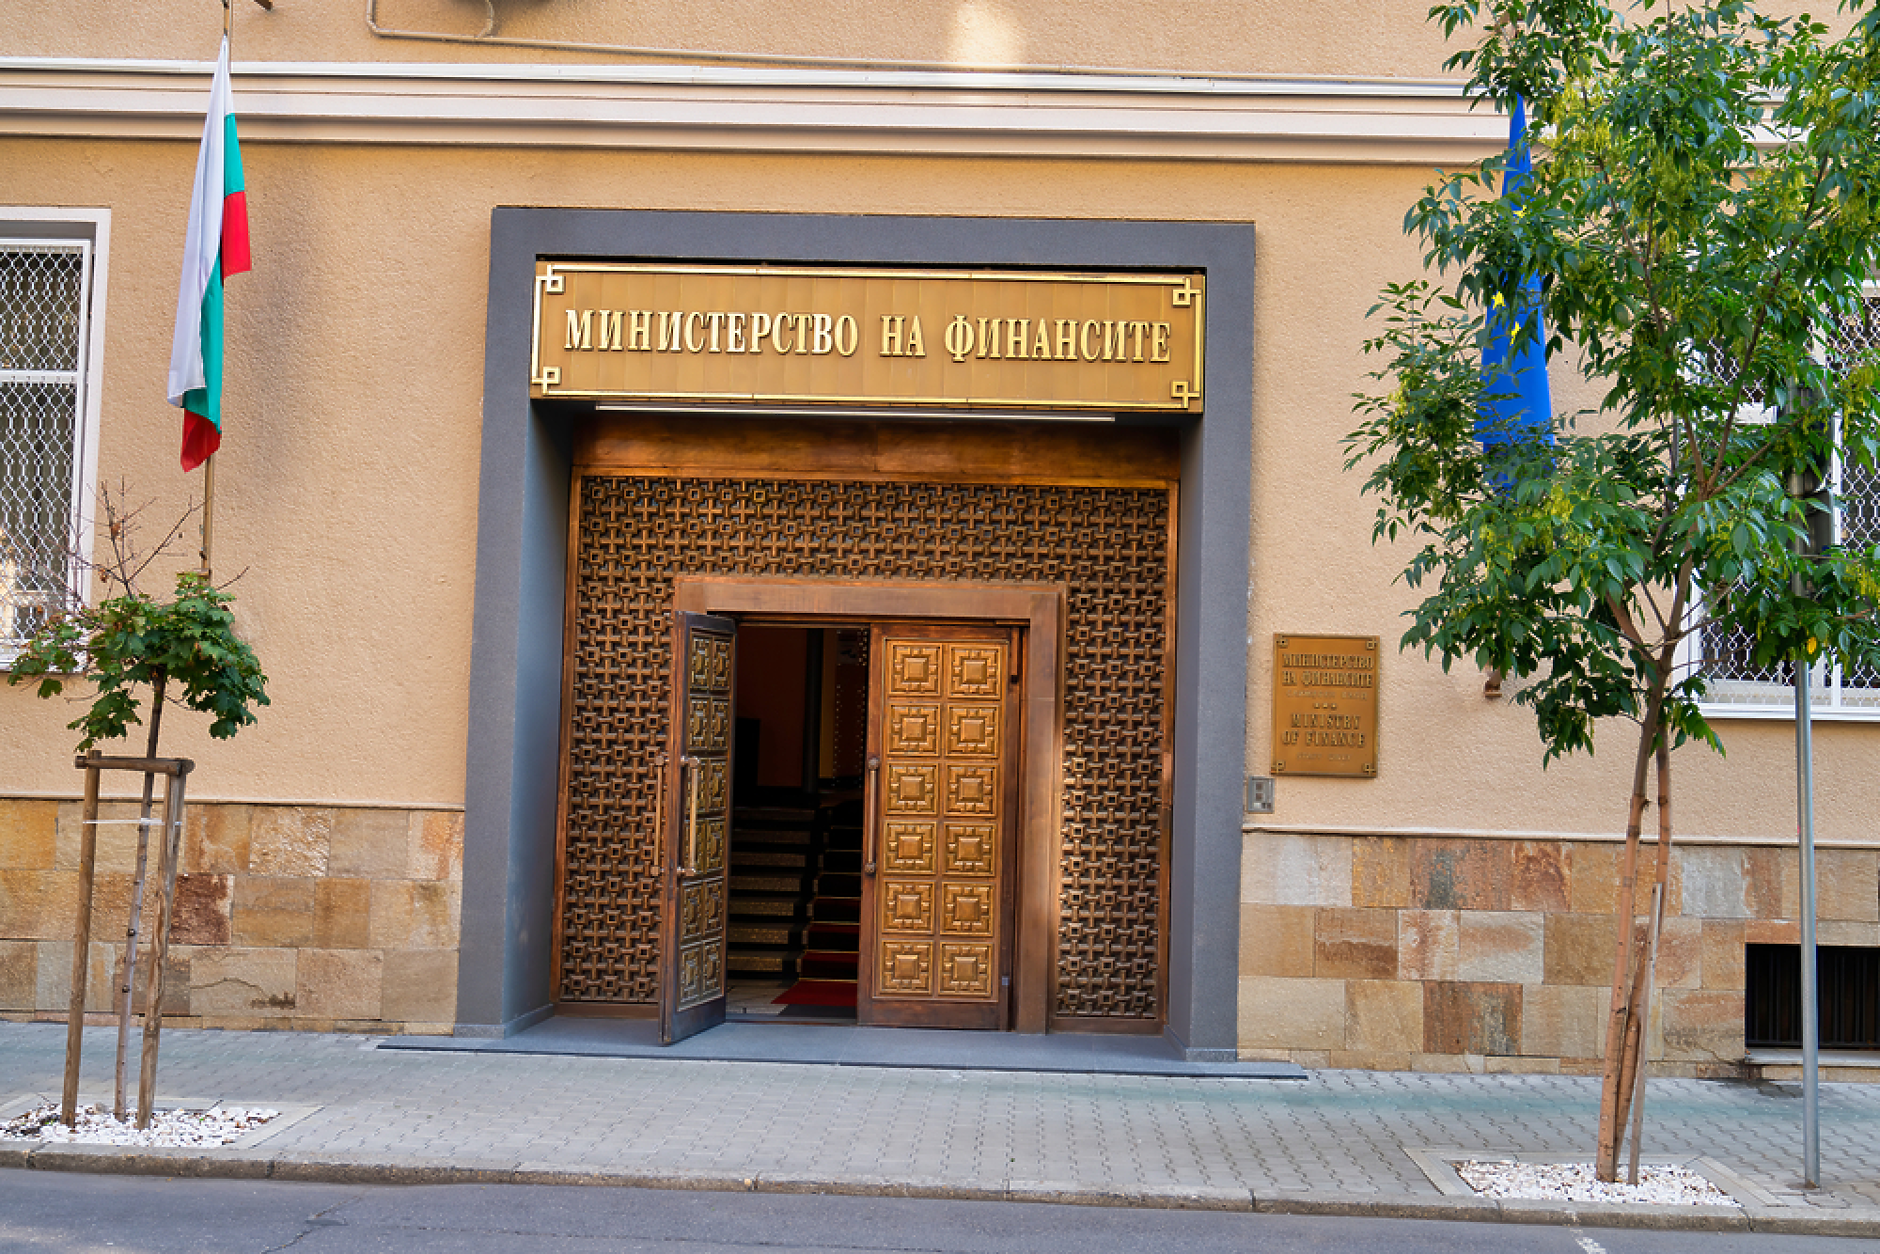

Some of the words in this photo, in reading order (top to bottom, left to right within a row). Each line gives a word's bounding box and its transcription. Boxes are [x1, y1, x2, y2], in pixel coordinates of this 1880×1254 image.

[564, 309, 858, 356] МИНИСТЕРСТВО
[879, 315, 926, 357] НА
[944, 314, 1171, 362] ФИНАНСИТЕ
[1282, 653, 1373, 670] МИНИСТЕРСТВО
[1282, 670, 1297, 686] НА
[1302, 671, 1373, 688] ФИНАНСИТЕ
[1291, 713, 1361, 730] MINISTRY
[1282, 730, 1299, 745] OF
[1305, 731, 1366, 748] FINANCE
